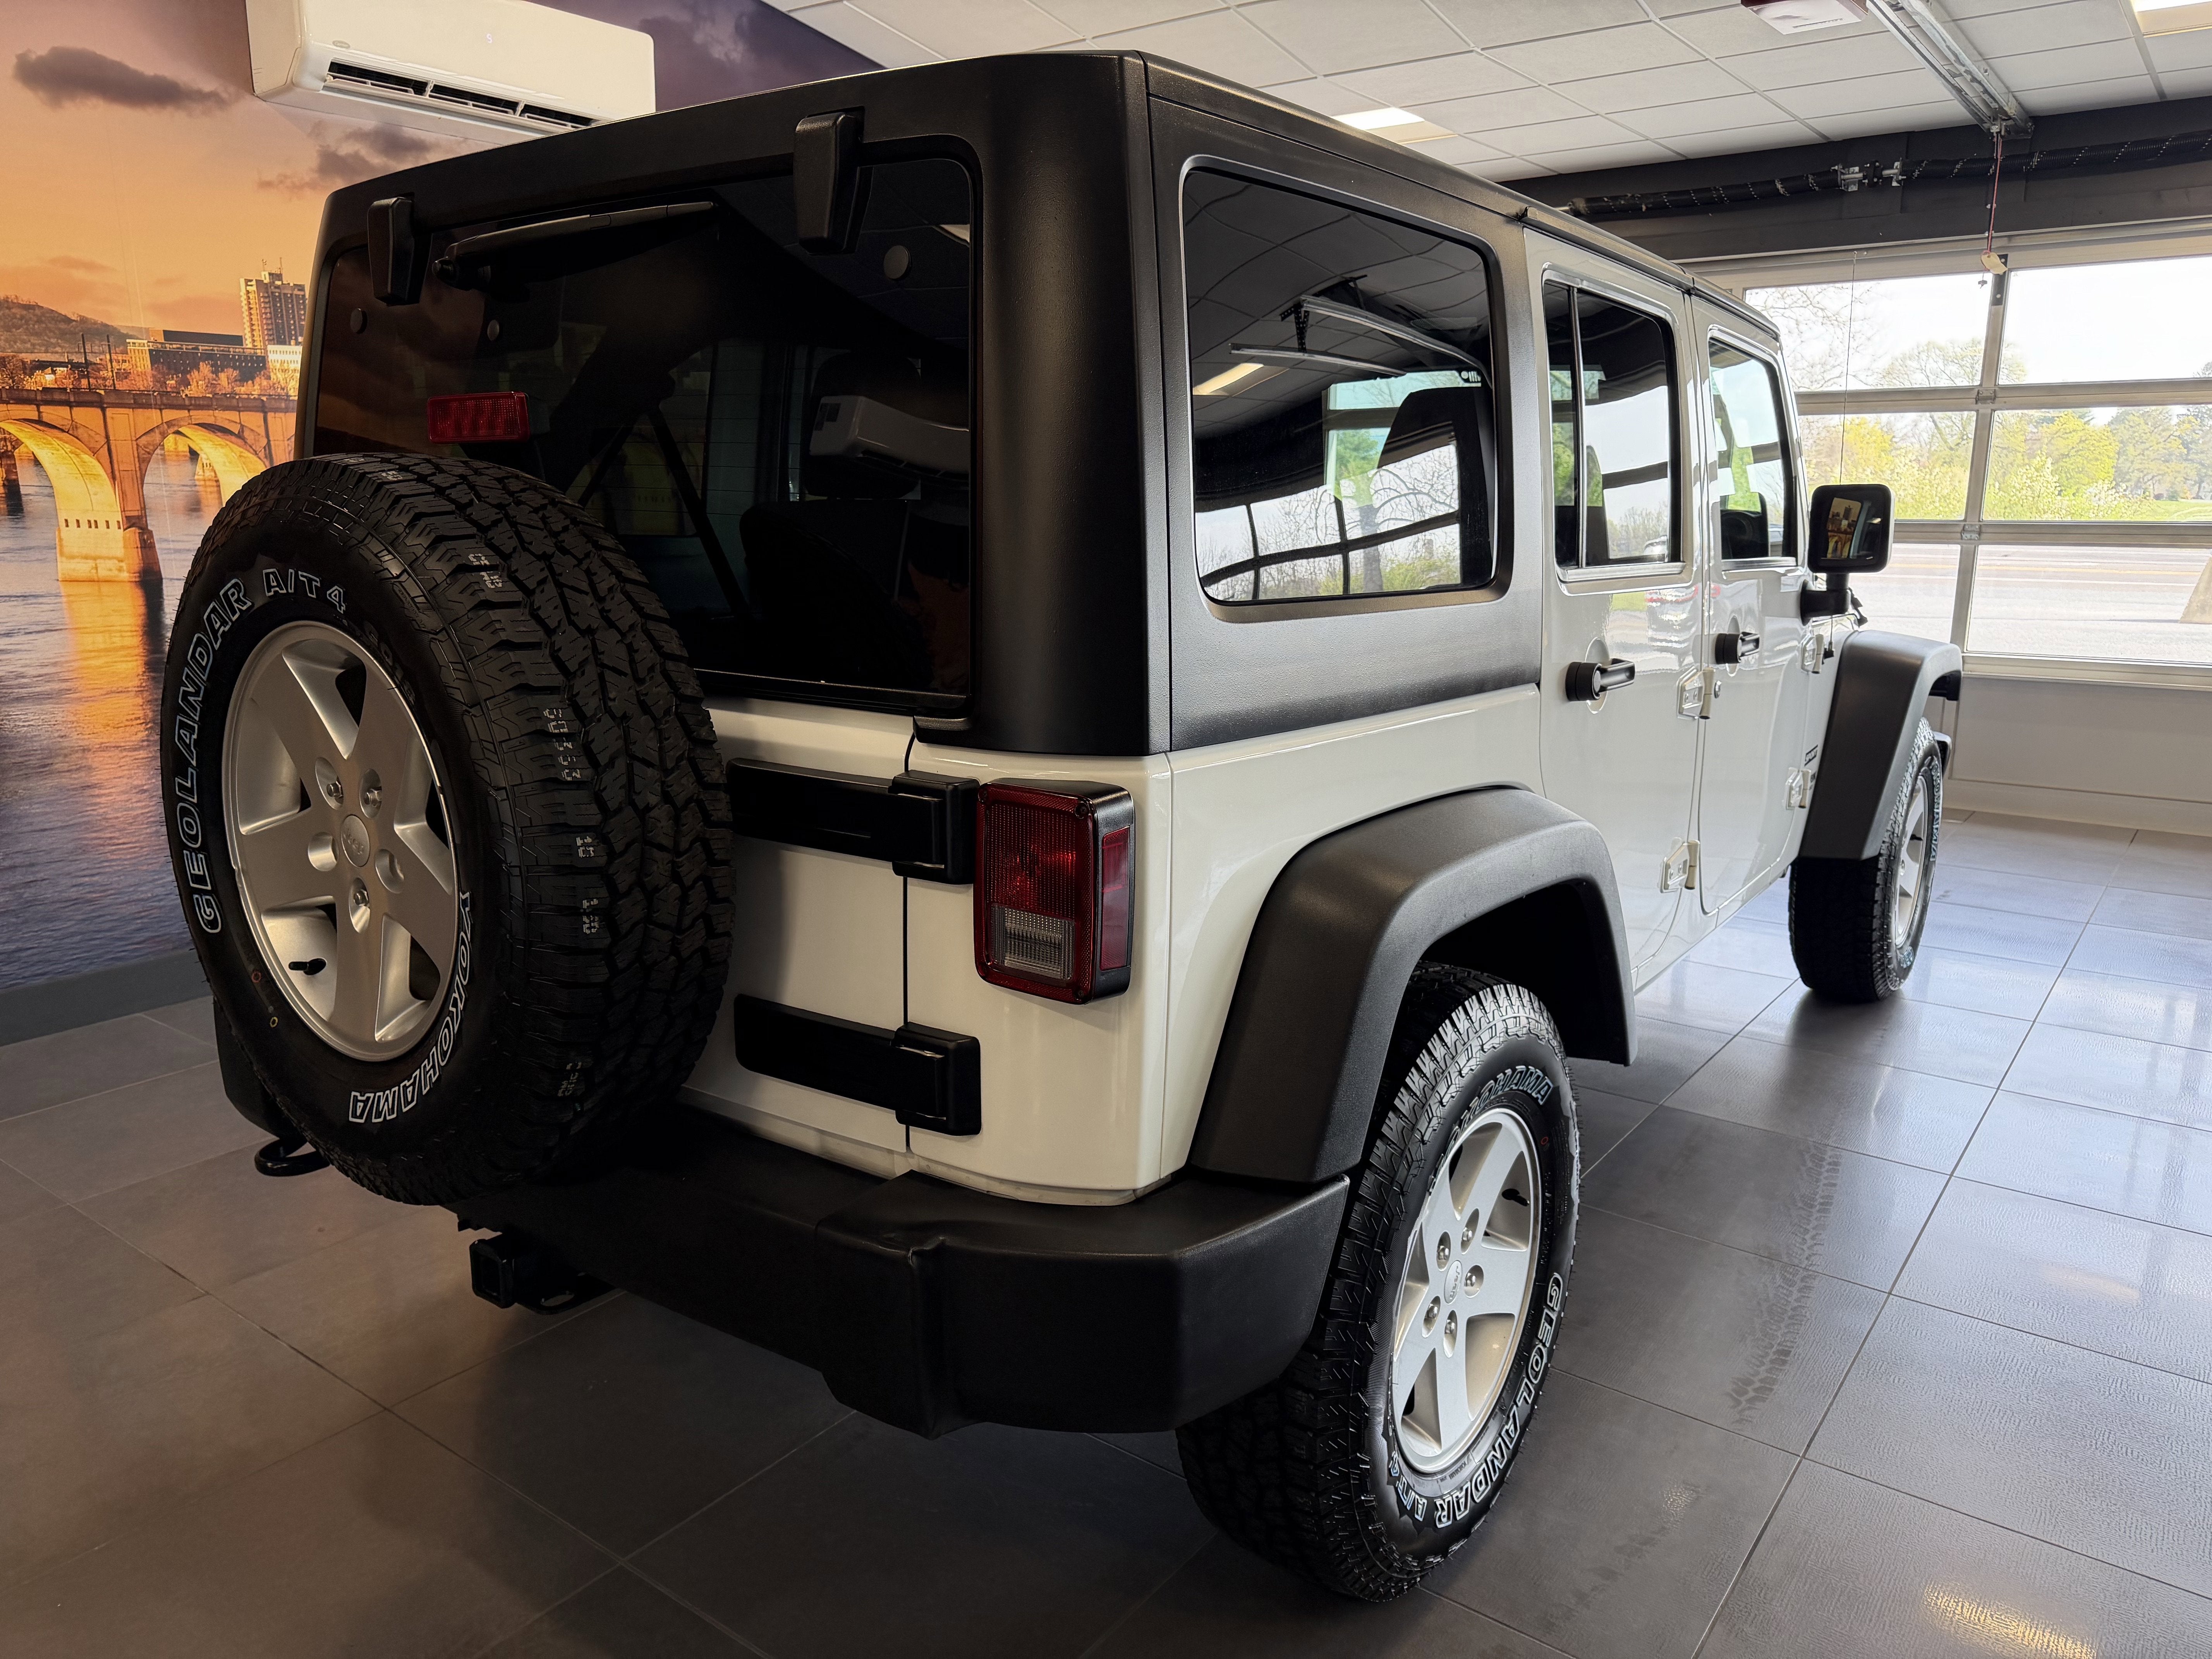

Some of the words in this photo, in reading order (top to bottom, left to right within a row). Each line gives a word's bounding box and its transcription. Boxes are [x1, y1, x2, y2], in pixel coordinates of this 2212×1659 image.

[173, 578, 252, 933] GEOLANDAR
[349, 890, 471, 1124] YOKOHAMA
[1435, 1272, 1563, 1529] GEOLANDAR
[1449, 1265, 1460, 1300] Jeep
